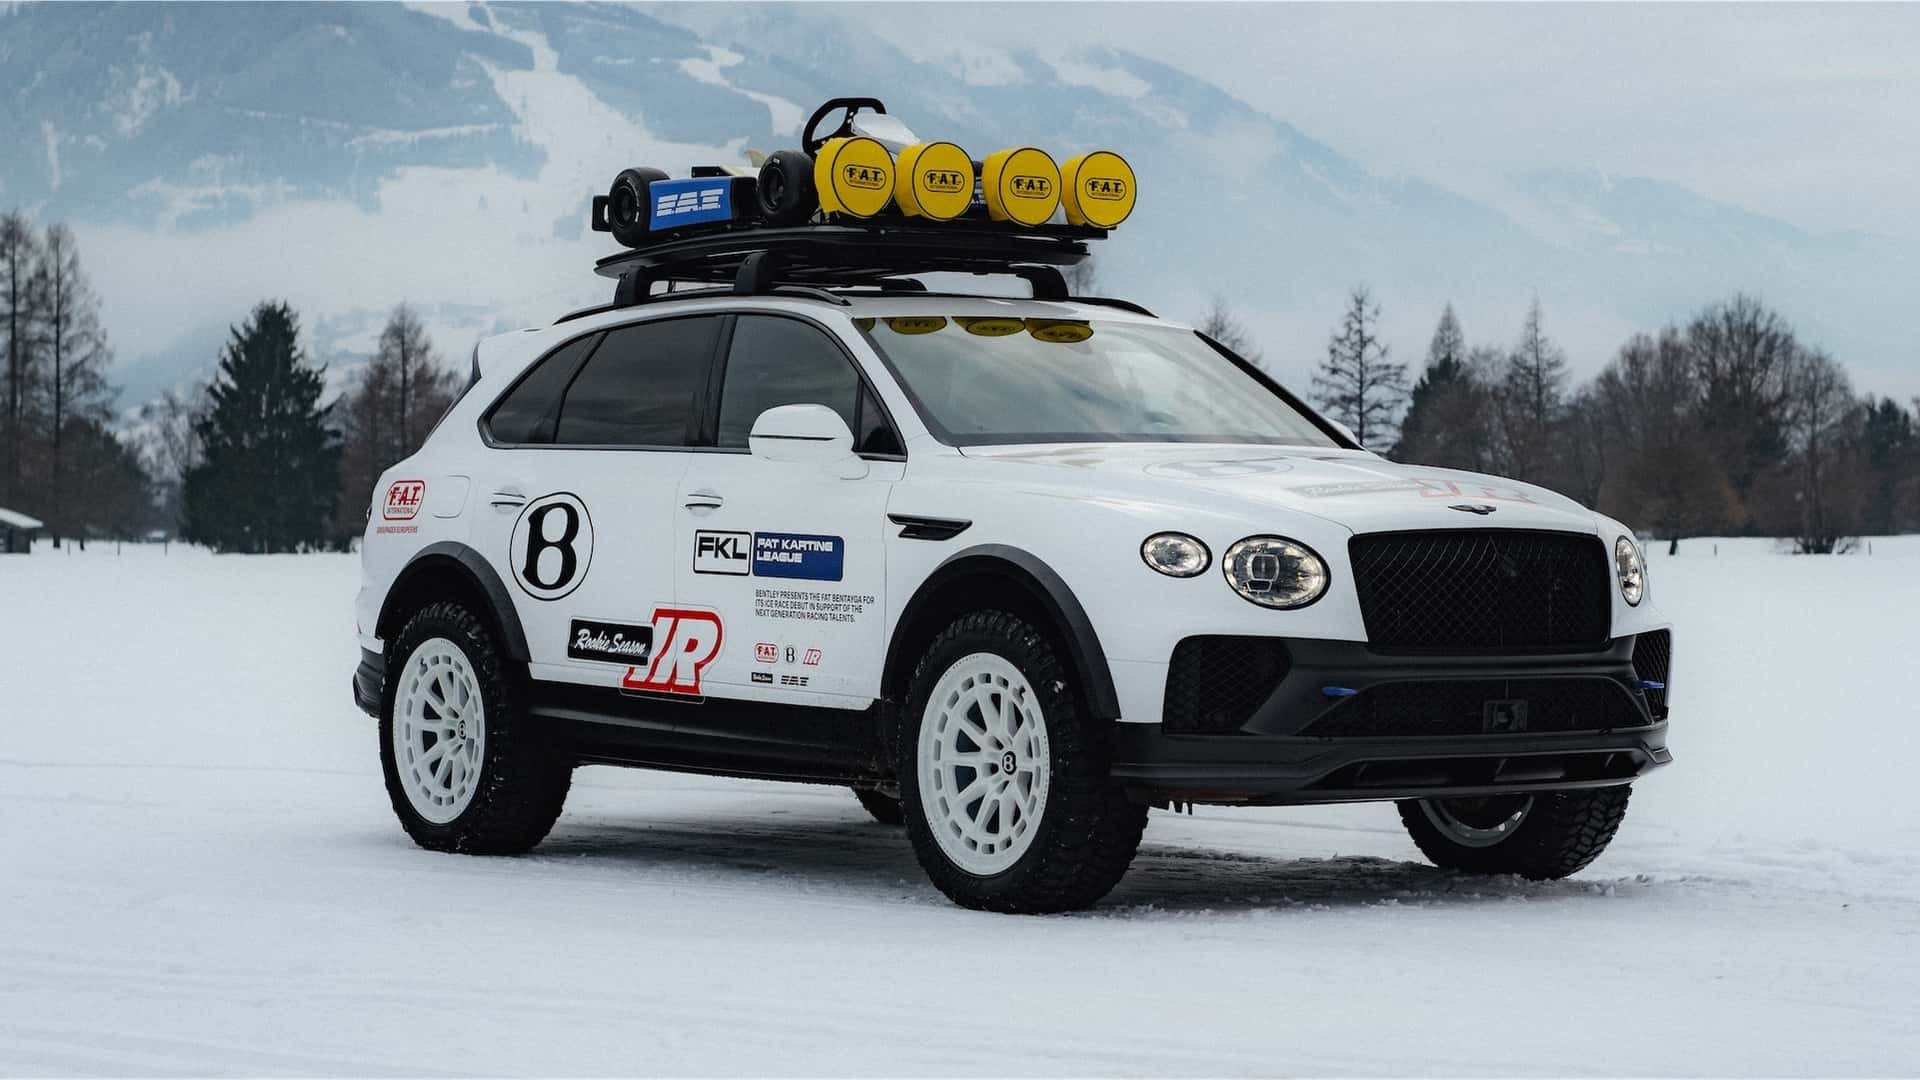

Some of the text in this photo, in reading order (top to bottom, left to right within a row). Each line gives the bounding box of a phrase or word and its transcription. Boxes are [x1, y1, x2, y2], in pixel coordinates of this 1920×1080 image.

[697, 536, 747, 560] FKL
[757, 538, 833, 552] FAT KARTING
[756, 550, 802, 563] LEAGUE
[780, 590, 809, 600] PRESENTS
[809, 592, 820, 601] THE
[755, 608, 769, 617] NEXT
[816, 602, 842, 612] SUPPORT
[842, 604, 851, 612] OF
[851, 604, 863, 613] THE
[575, 628, 646, 655] Rookie Season
